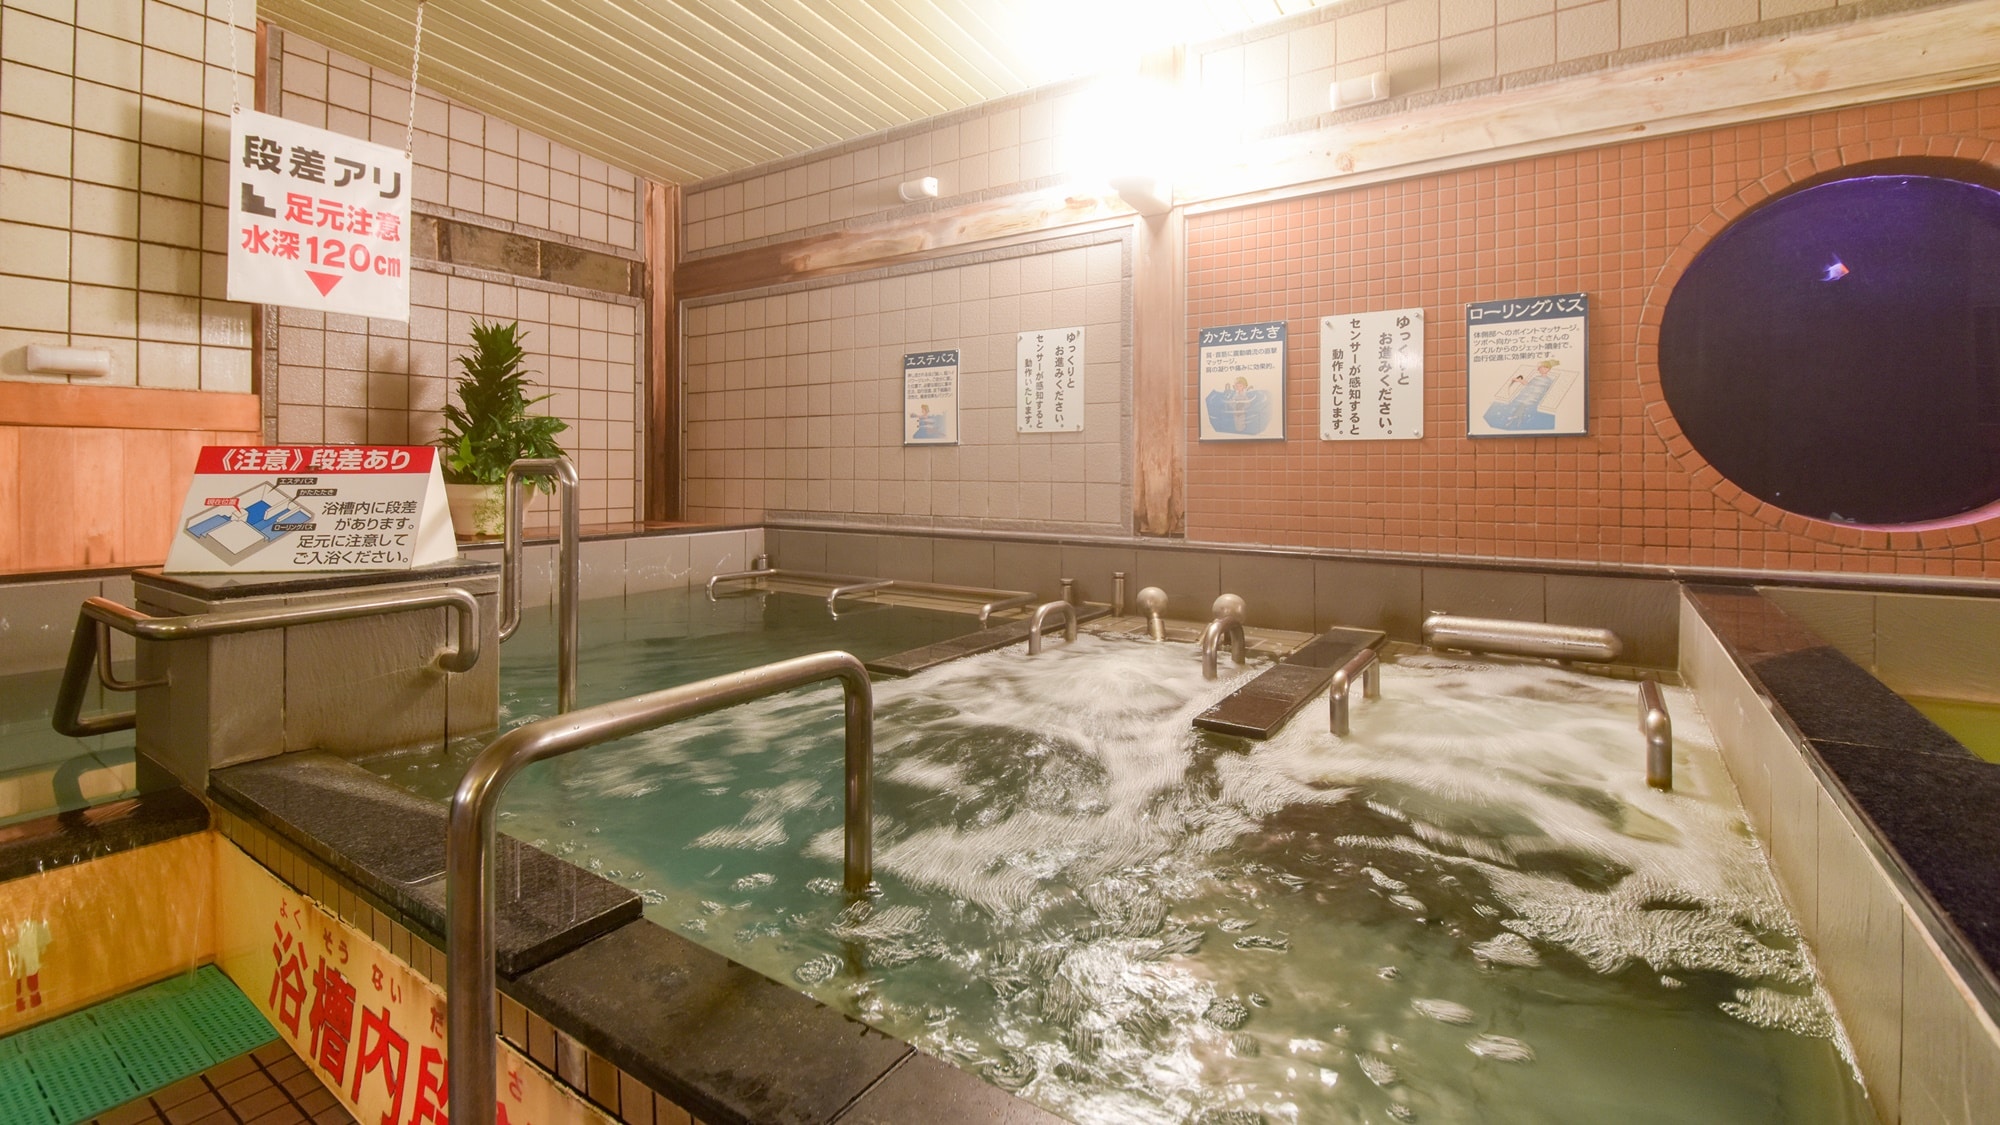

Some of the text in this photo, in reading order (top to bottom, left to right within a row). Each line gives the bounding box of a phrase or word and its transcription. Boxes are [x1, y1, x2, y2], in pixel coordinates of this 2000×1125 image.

[242, 135, 401, 199] 段差アリ
[284, 192, 401, 242] 足元注意
[1202, 325, 1281, 344] かたたたき
[1470, 298, 1585, 320] ローリングバス
[906, 353, 956, 366] エステバス
[1066, 331, 1076, 389] ゆっくりと
[1349, 318, 1361, 436] センサーが感知すると
[1396, 315, 1411, 386] ゆっくと
[1024, 358, 1033, 429] 動作いたします。
[1035, 334, 1044, 429] センサーが感知すると
[1054, 346, 1064, 429] お進みください。
[1332, 348, 1344, 435] 動作いたします。
[1378, 332, 1393, 435] お進みください。
[222, 448, 411, 471] 《注意》段差あり
[322, 500, 417, 515] 浴槽内に段差
[334, 517, 415, 531] があります。
[293, 551, 409, 565] ご入浴ください。
[296, 534, 409, 548] 足元に注意して
[280, 897, 301, 930] よく
[323, 927, 349, 964] そう
[371, 962, 402, 1004] ない
